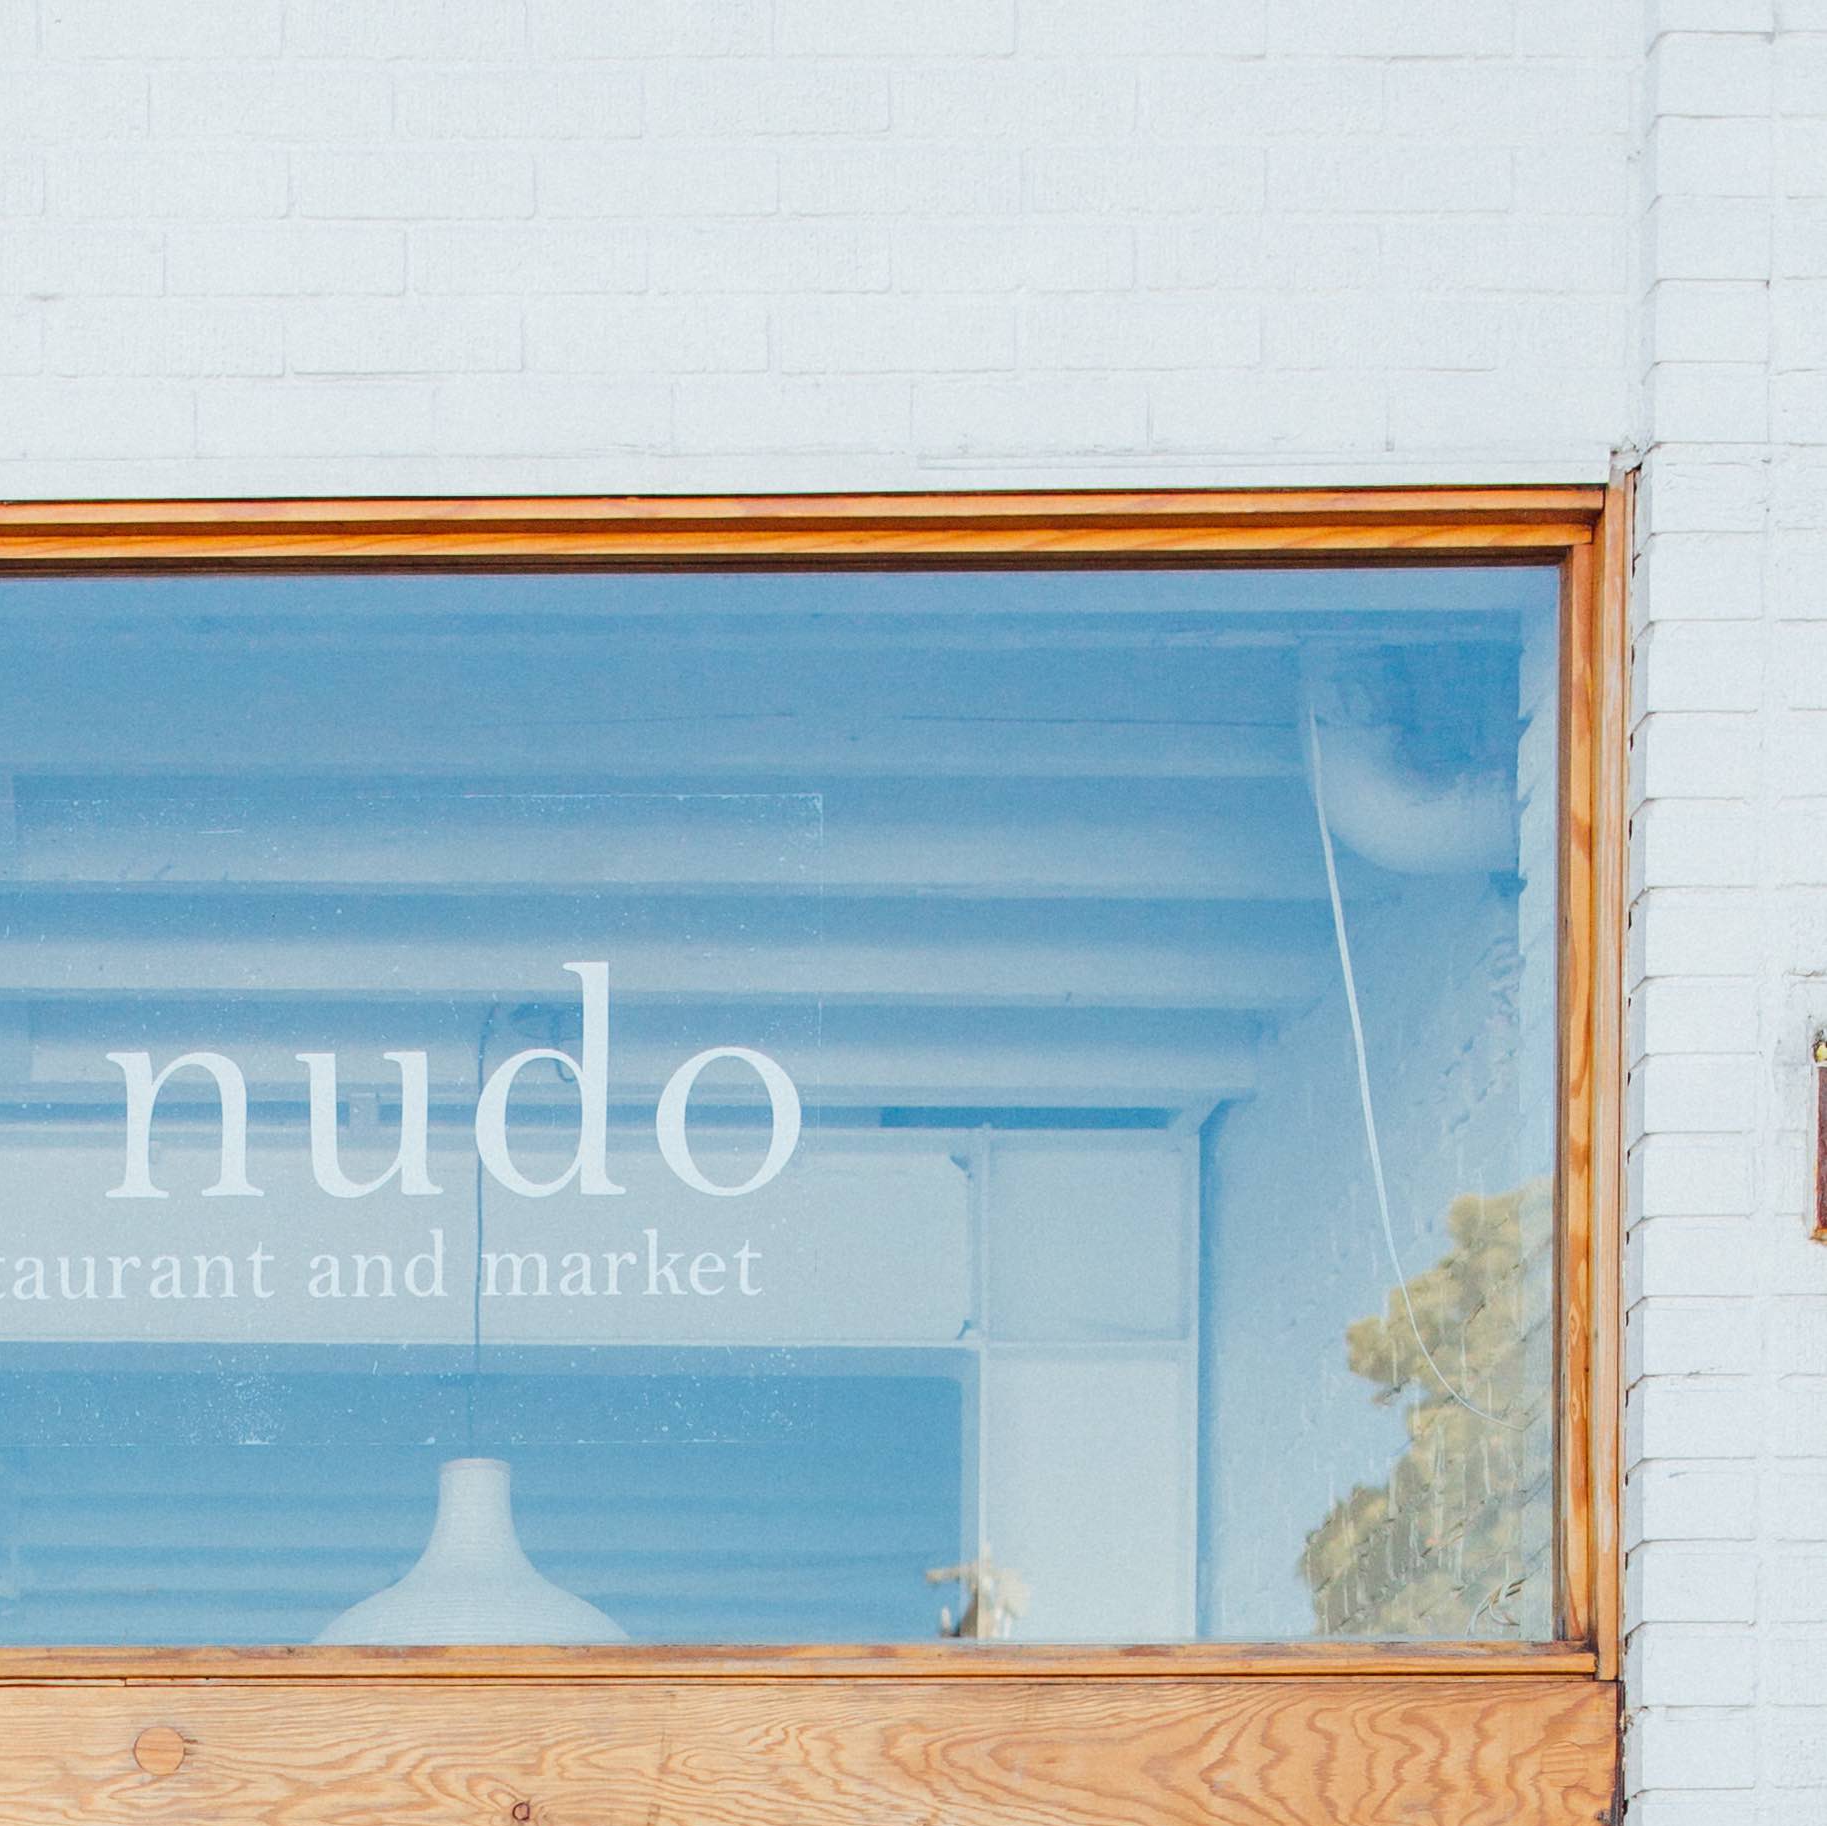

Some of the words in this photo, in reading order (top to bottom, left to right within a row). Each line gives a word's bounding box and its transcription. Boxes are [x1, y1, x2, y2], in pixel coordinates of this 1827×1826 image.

[104, 961, 801, 1198] nudo
[308, 1229, 448, 1298] and
[481, 1228, 764, 1297] market
